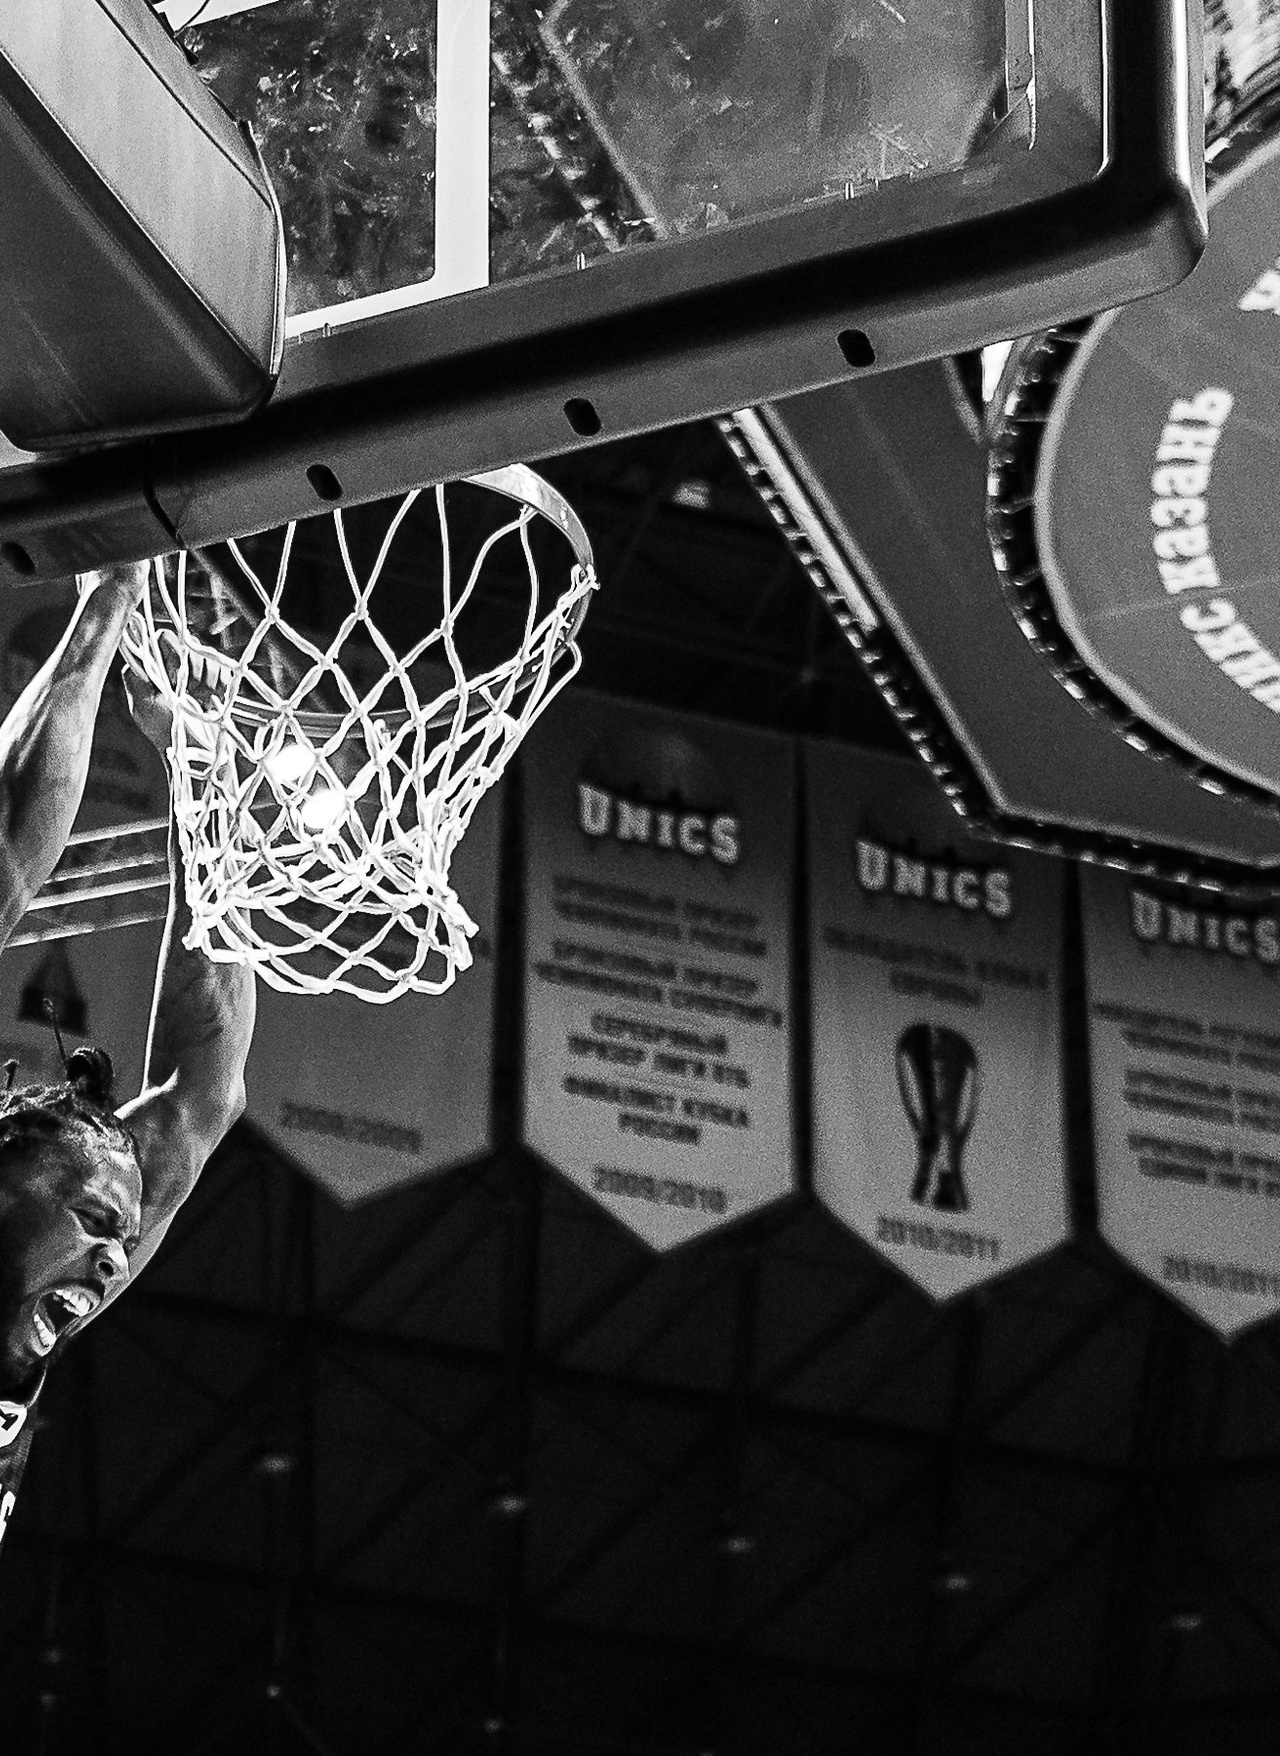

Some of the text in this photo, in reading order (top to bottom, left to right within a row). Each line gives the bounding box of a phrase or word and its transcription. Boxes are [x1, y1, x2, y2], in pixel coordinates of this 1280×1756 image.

[577, 783, 739, 864] UNICS
[856, 840, 1012, 917] UNICS
[1131, 891, 1280, 963] UNICS
